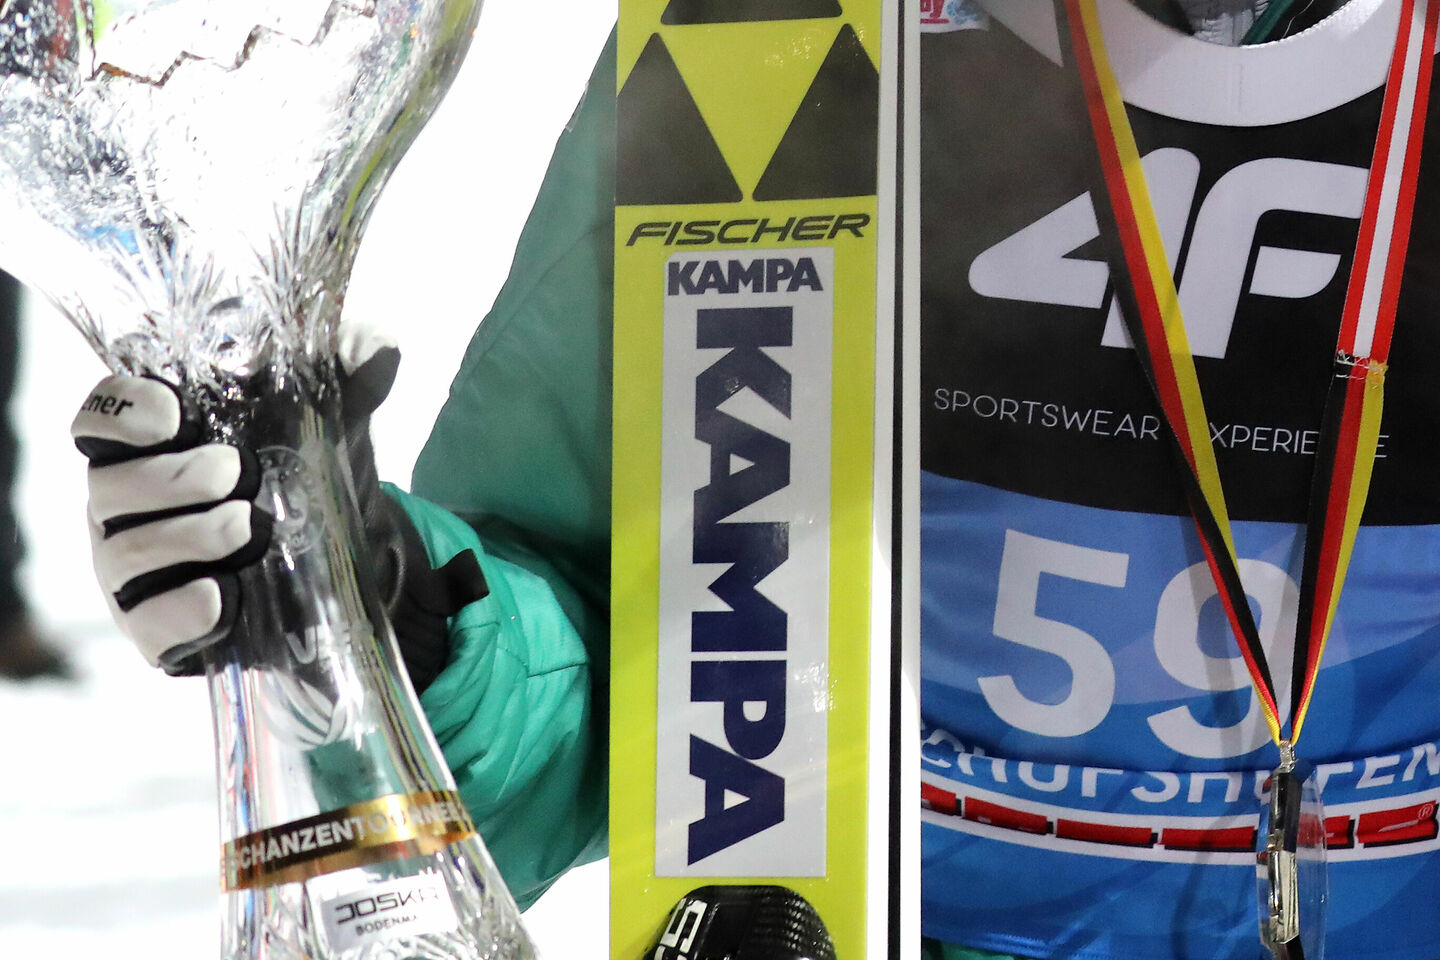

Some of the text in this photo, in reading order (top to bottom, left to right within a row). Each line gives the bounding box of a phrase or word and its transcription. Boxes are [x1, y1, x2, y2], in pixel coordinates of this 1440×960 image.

[626, 213, 871, 247] FISCHER
[968, 147, 1371, 360] 4F
[667, 257, 824, 296] KAMPA
[82, 393, 134, 417] ner
[933, 388, 1390, 459] SPORTSWEAR XPERIEE
[687, 306, 794, 867] KAMPA
[977, 528, 1299, 760] 59
